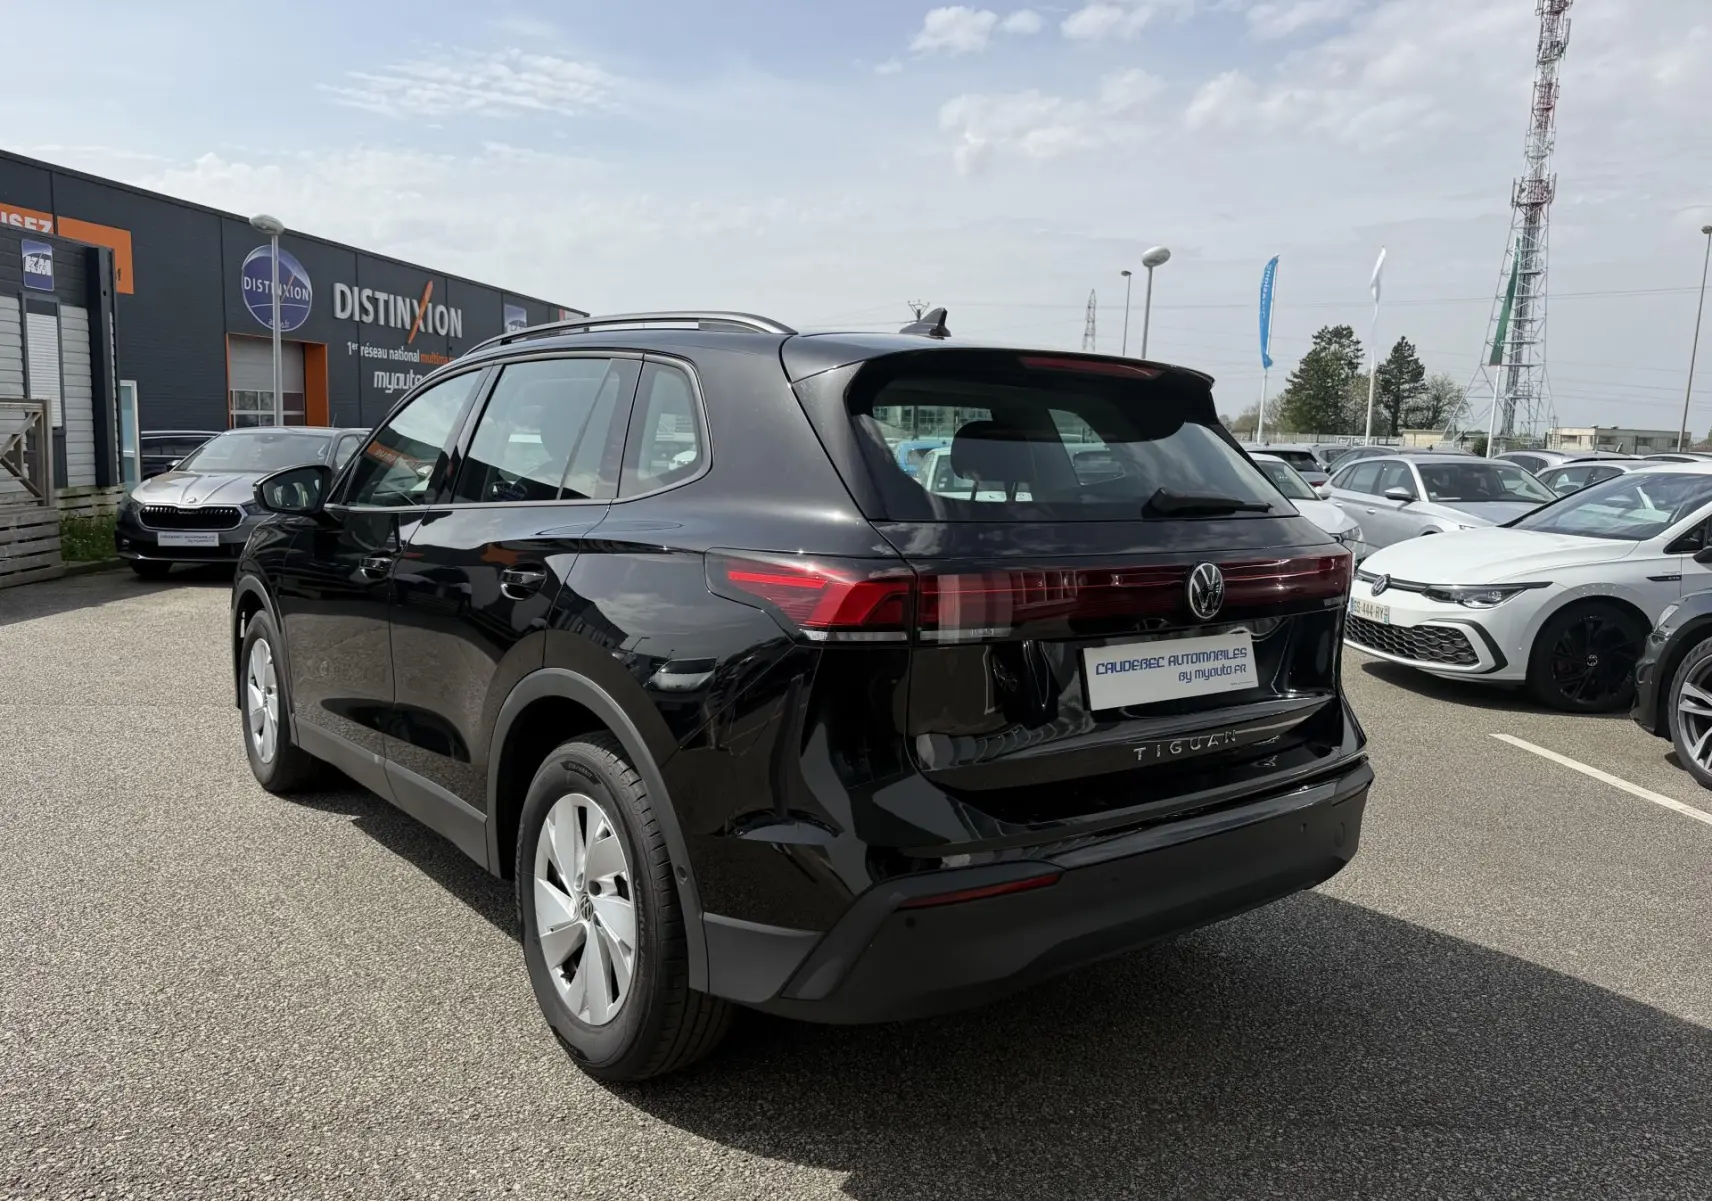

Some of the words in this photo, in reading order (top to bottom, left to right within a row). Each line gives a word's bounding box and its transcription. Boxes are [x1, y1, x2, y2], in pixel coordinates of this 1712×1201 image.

[243, 276, 309, 301] DISTIXION
[333, 280, 463, 343] DISTINXION
[360, 342, 388, 359] réseau
[389, 345, 420, 363] national
[1095, 656, 1165, 675] CAUDEBEC
[1168, 647, 1248, 667] AUTOMOBILES
[1133, 729, 1236, 761] TIGUAN
